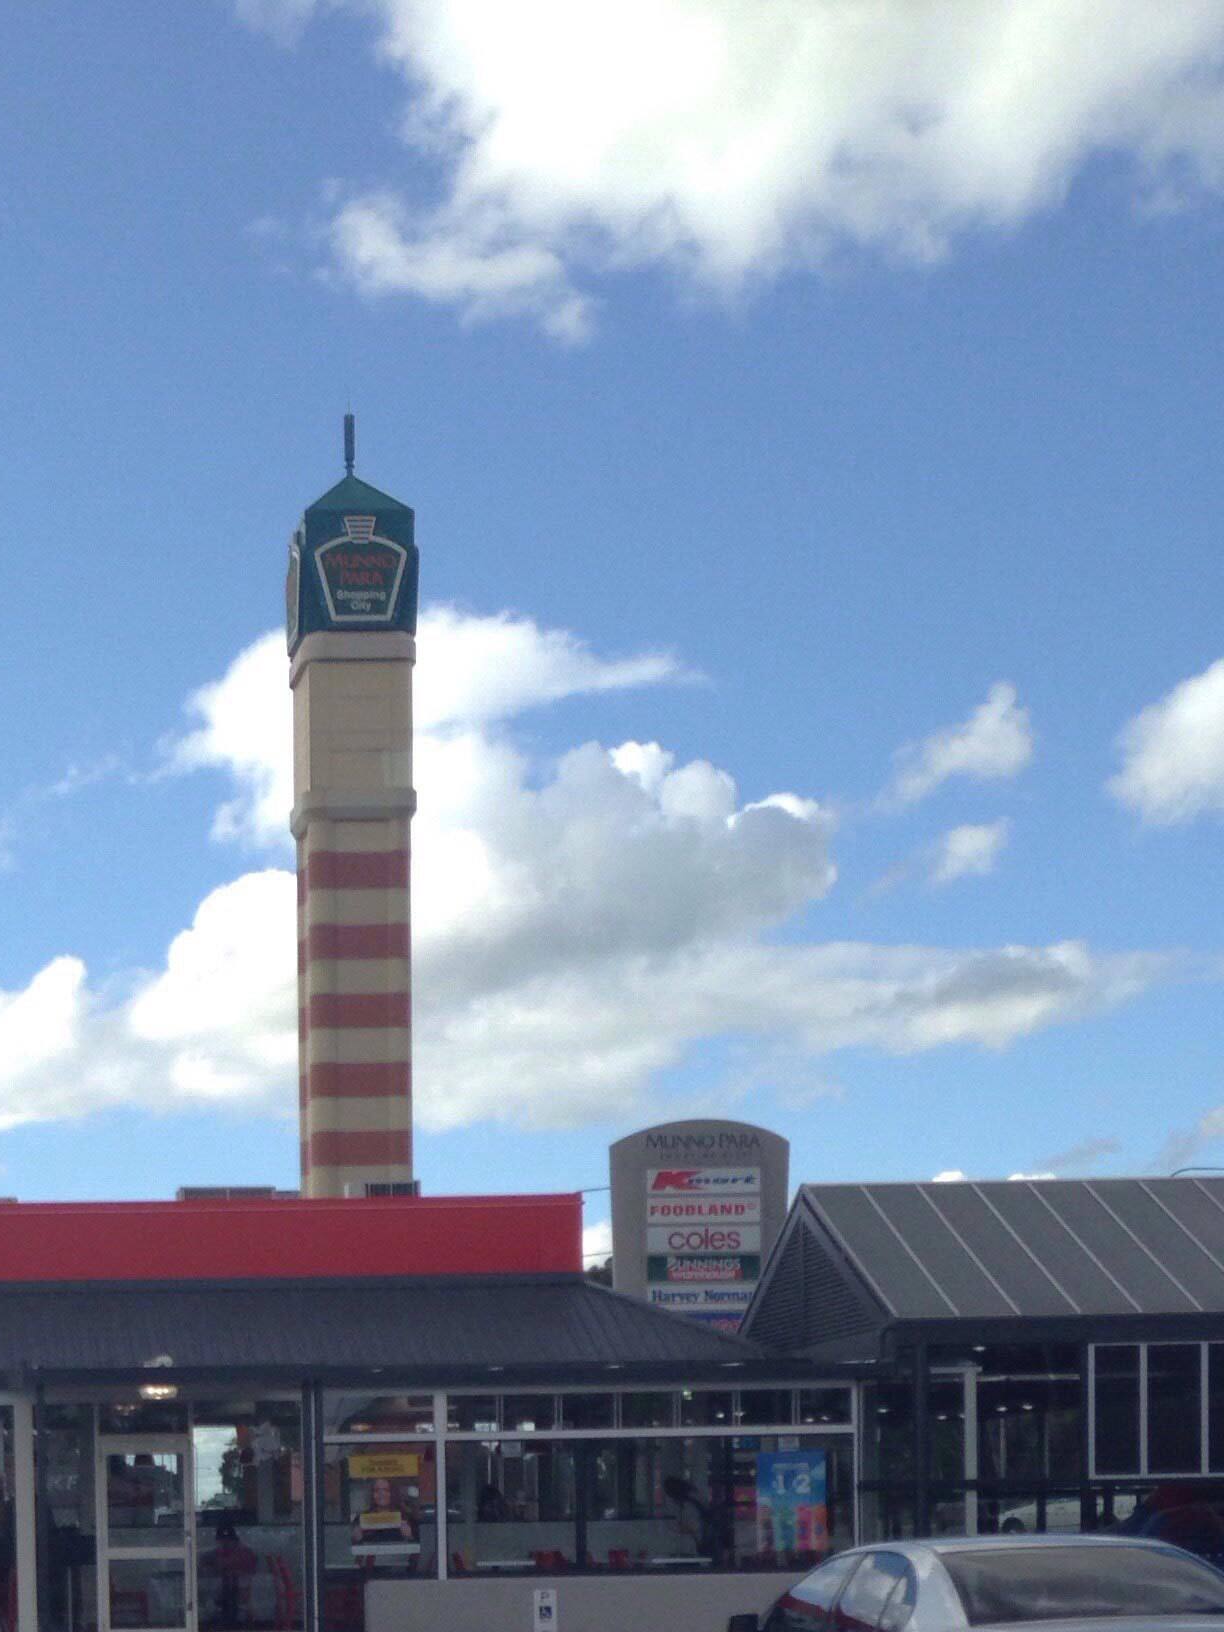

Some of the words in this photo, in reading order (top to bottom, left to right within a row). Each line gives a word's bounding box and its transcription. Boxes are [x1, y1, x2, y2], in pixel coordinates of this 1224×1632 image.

[647, 1133, 715, 1149] MUNNO
[719, 1132, 760, 1149] PARA
[651, 1170, 757, 1191] Kmart
[650, 1203, 745, 1217] FOODLAND
[668, 1227, 741, 1250] coles
[652, 1289, 698, 1304] Harvey
